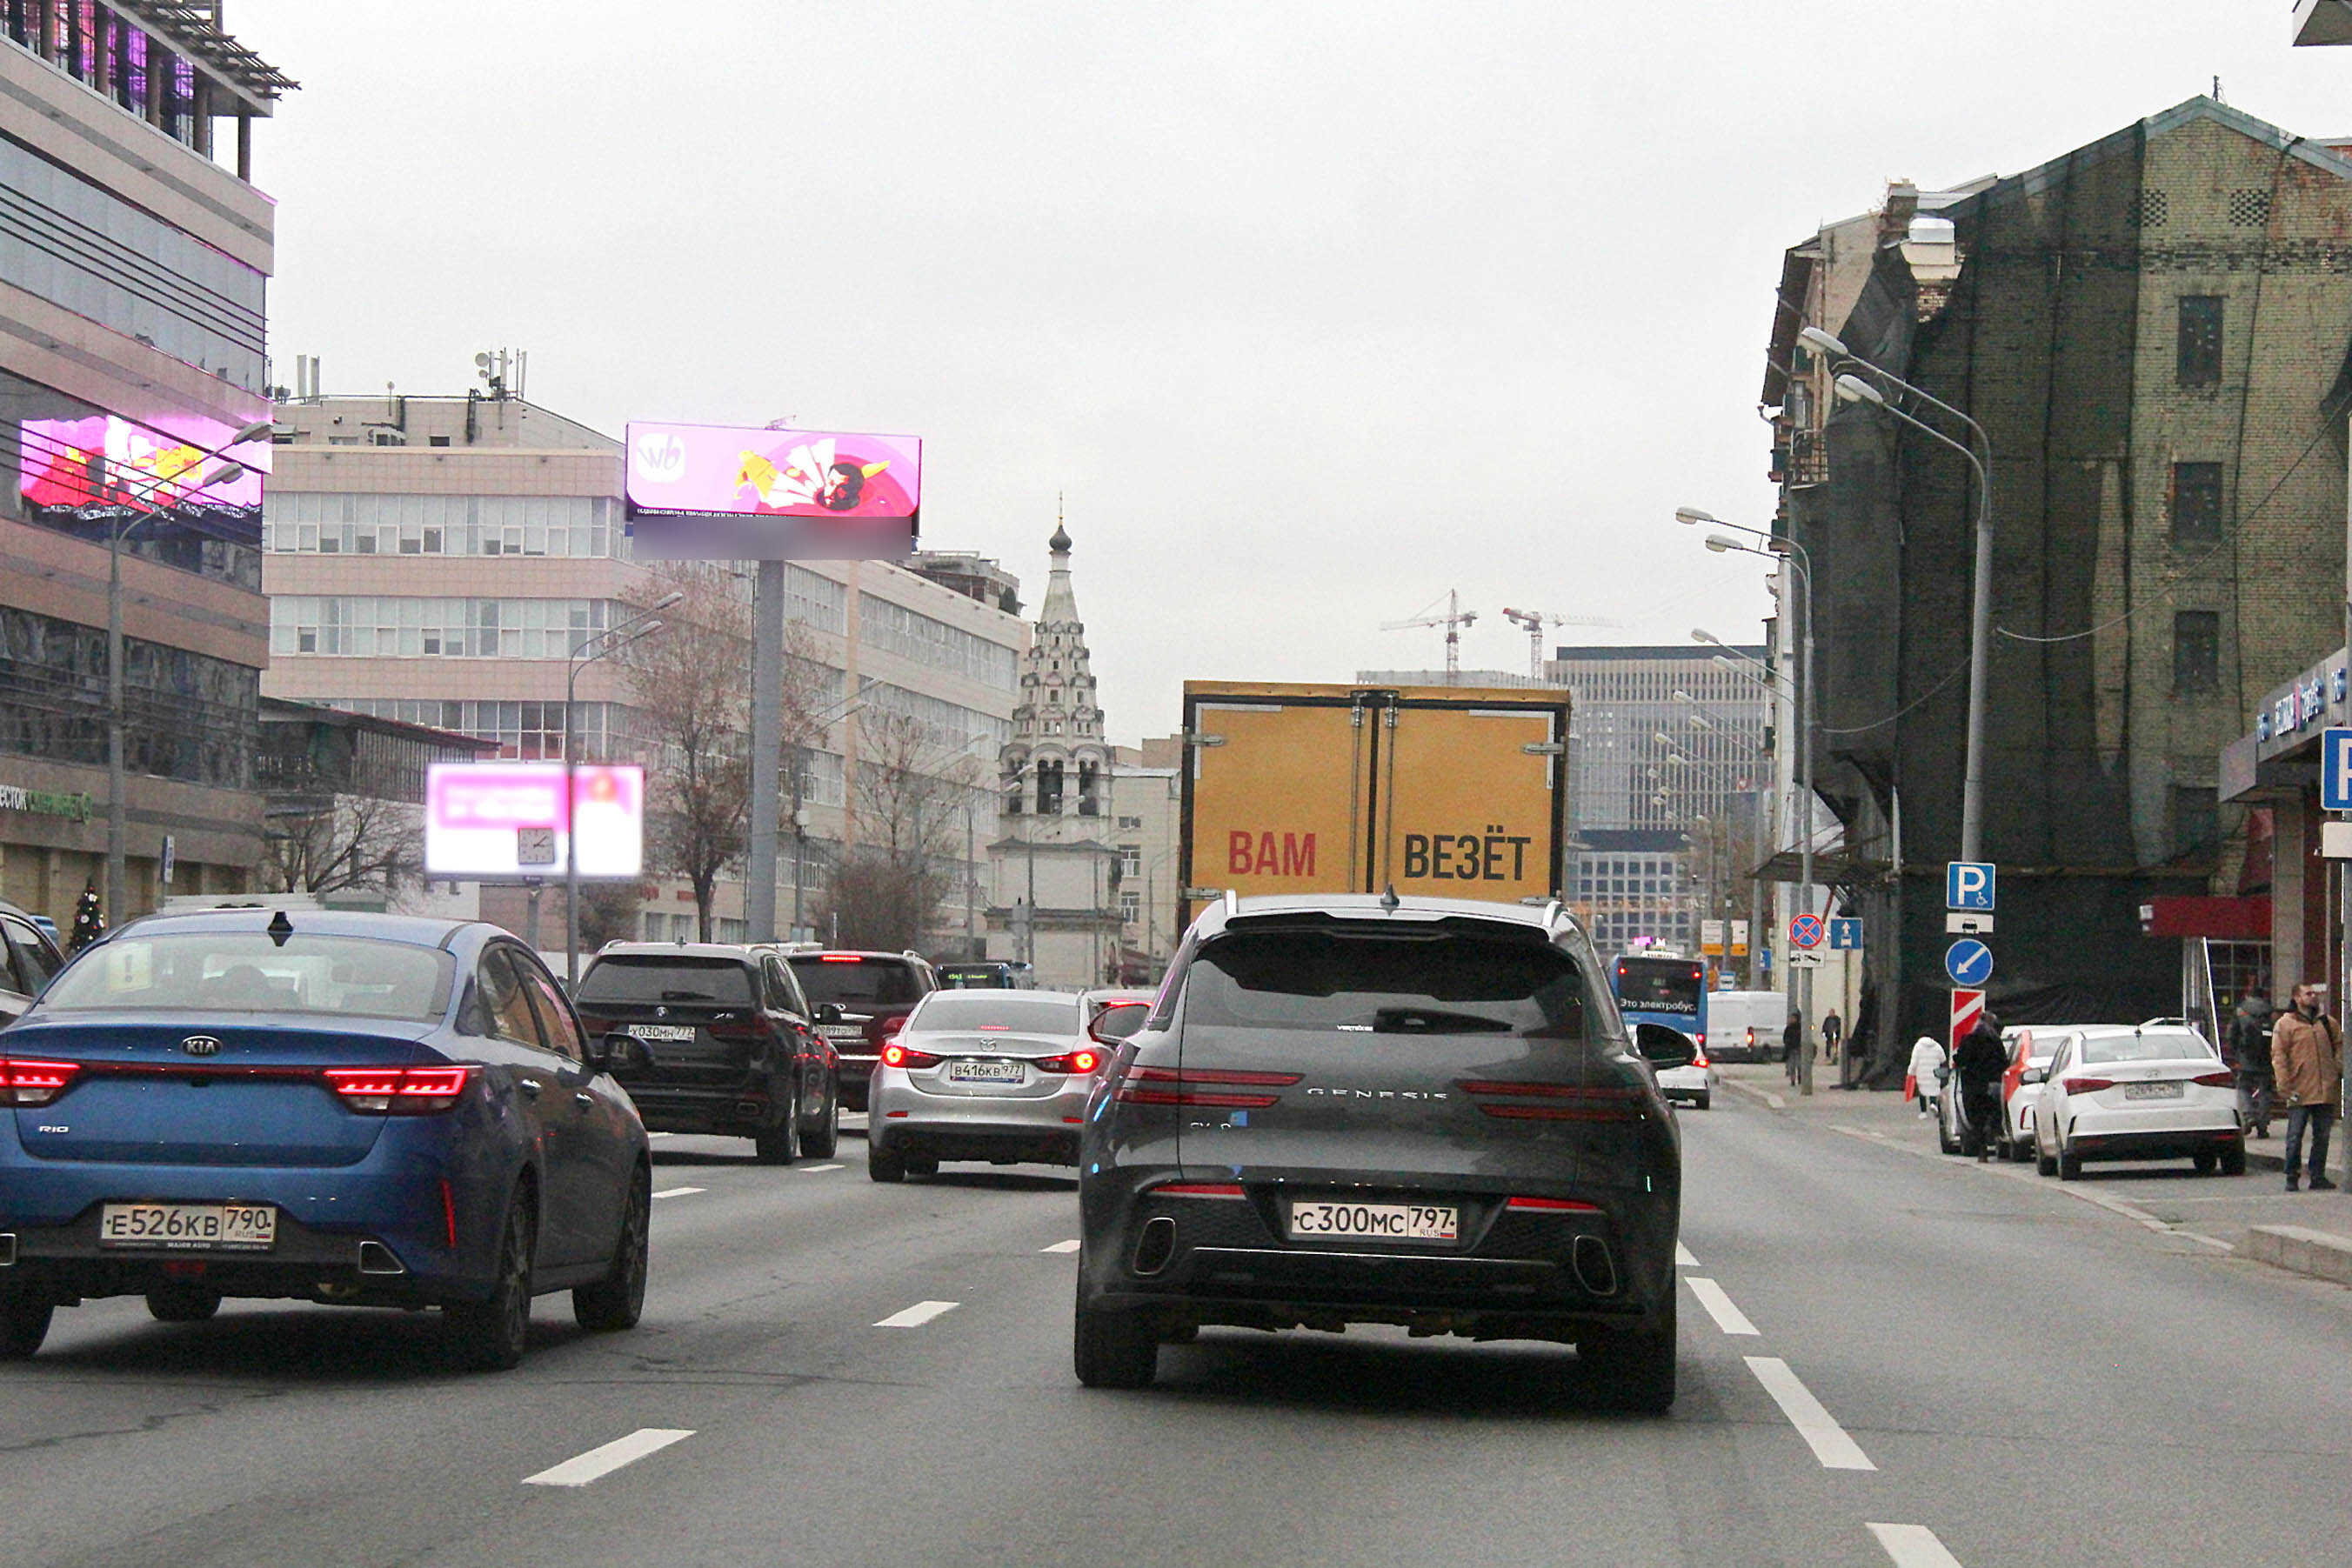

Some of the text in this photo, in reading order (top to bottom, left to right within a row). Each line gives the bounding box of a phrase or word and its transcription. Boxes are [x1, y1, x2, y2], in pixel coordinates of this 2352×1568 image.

[1228, 824, 1532, 881] ВАМ ВЕЗЁТ
[1957, 866, 1986, 904] P
[1620, 998, 1638, 1008] Это
[185, 1040, 217, 1054] KIA
[954, 1064, 1001, 1078] В416КВ
[1307, 1087, 1448, 1099] GENESIS
[111, 1209, 269, 1237] Е526КВ 790
[1299, 1205, 1453, 1234] С300МС 797
[235, 1231, 255, 1239] RUS
[1420, 1229, 1440, 1238] RUS
